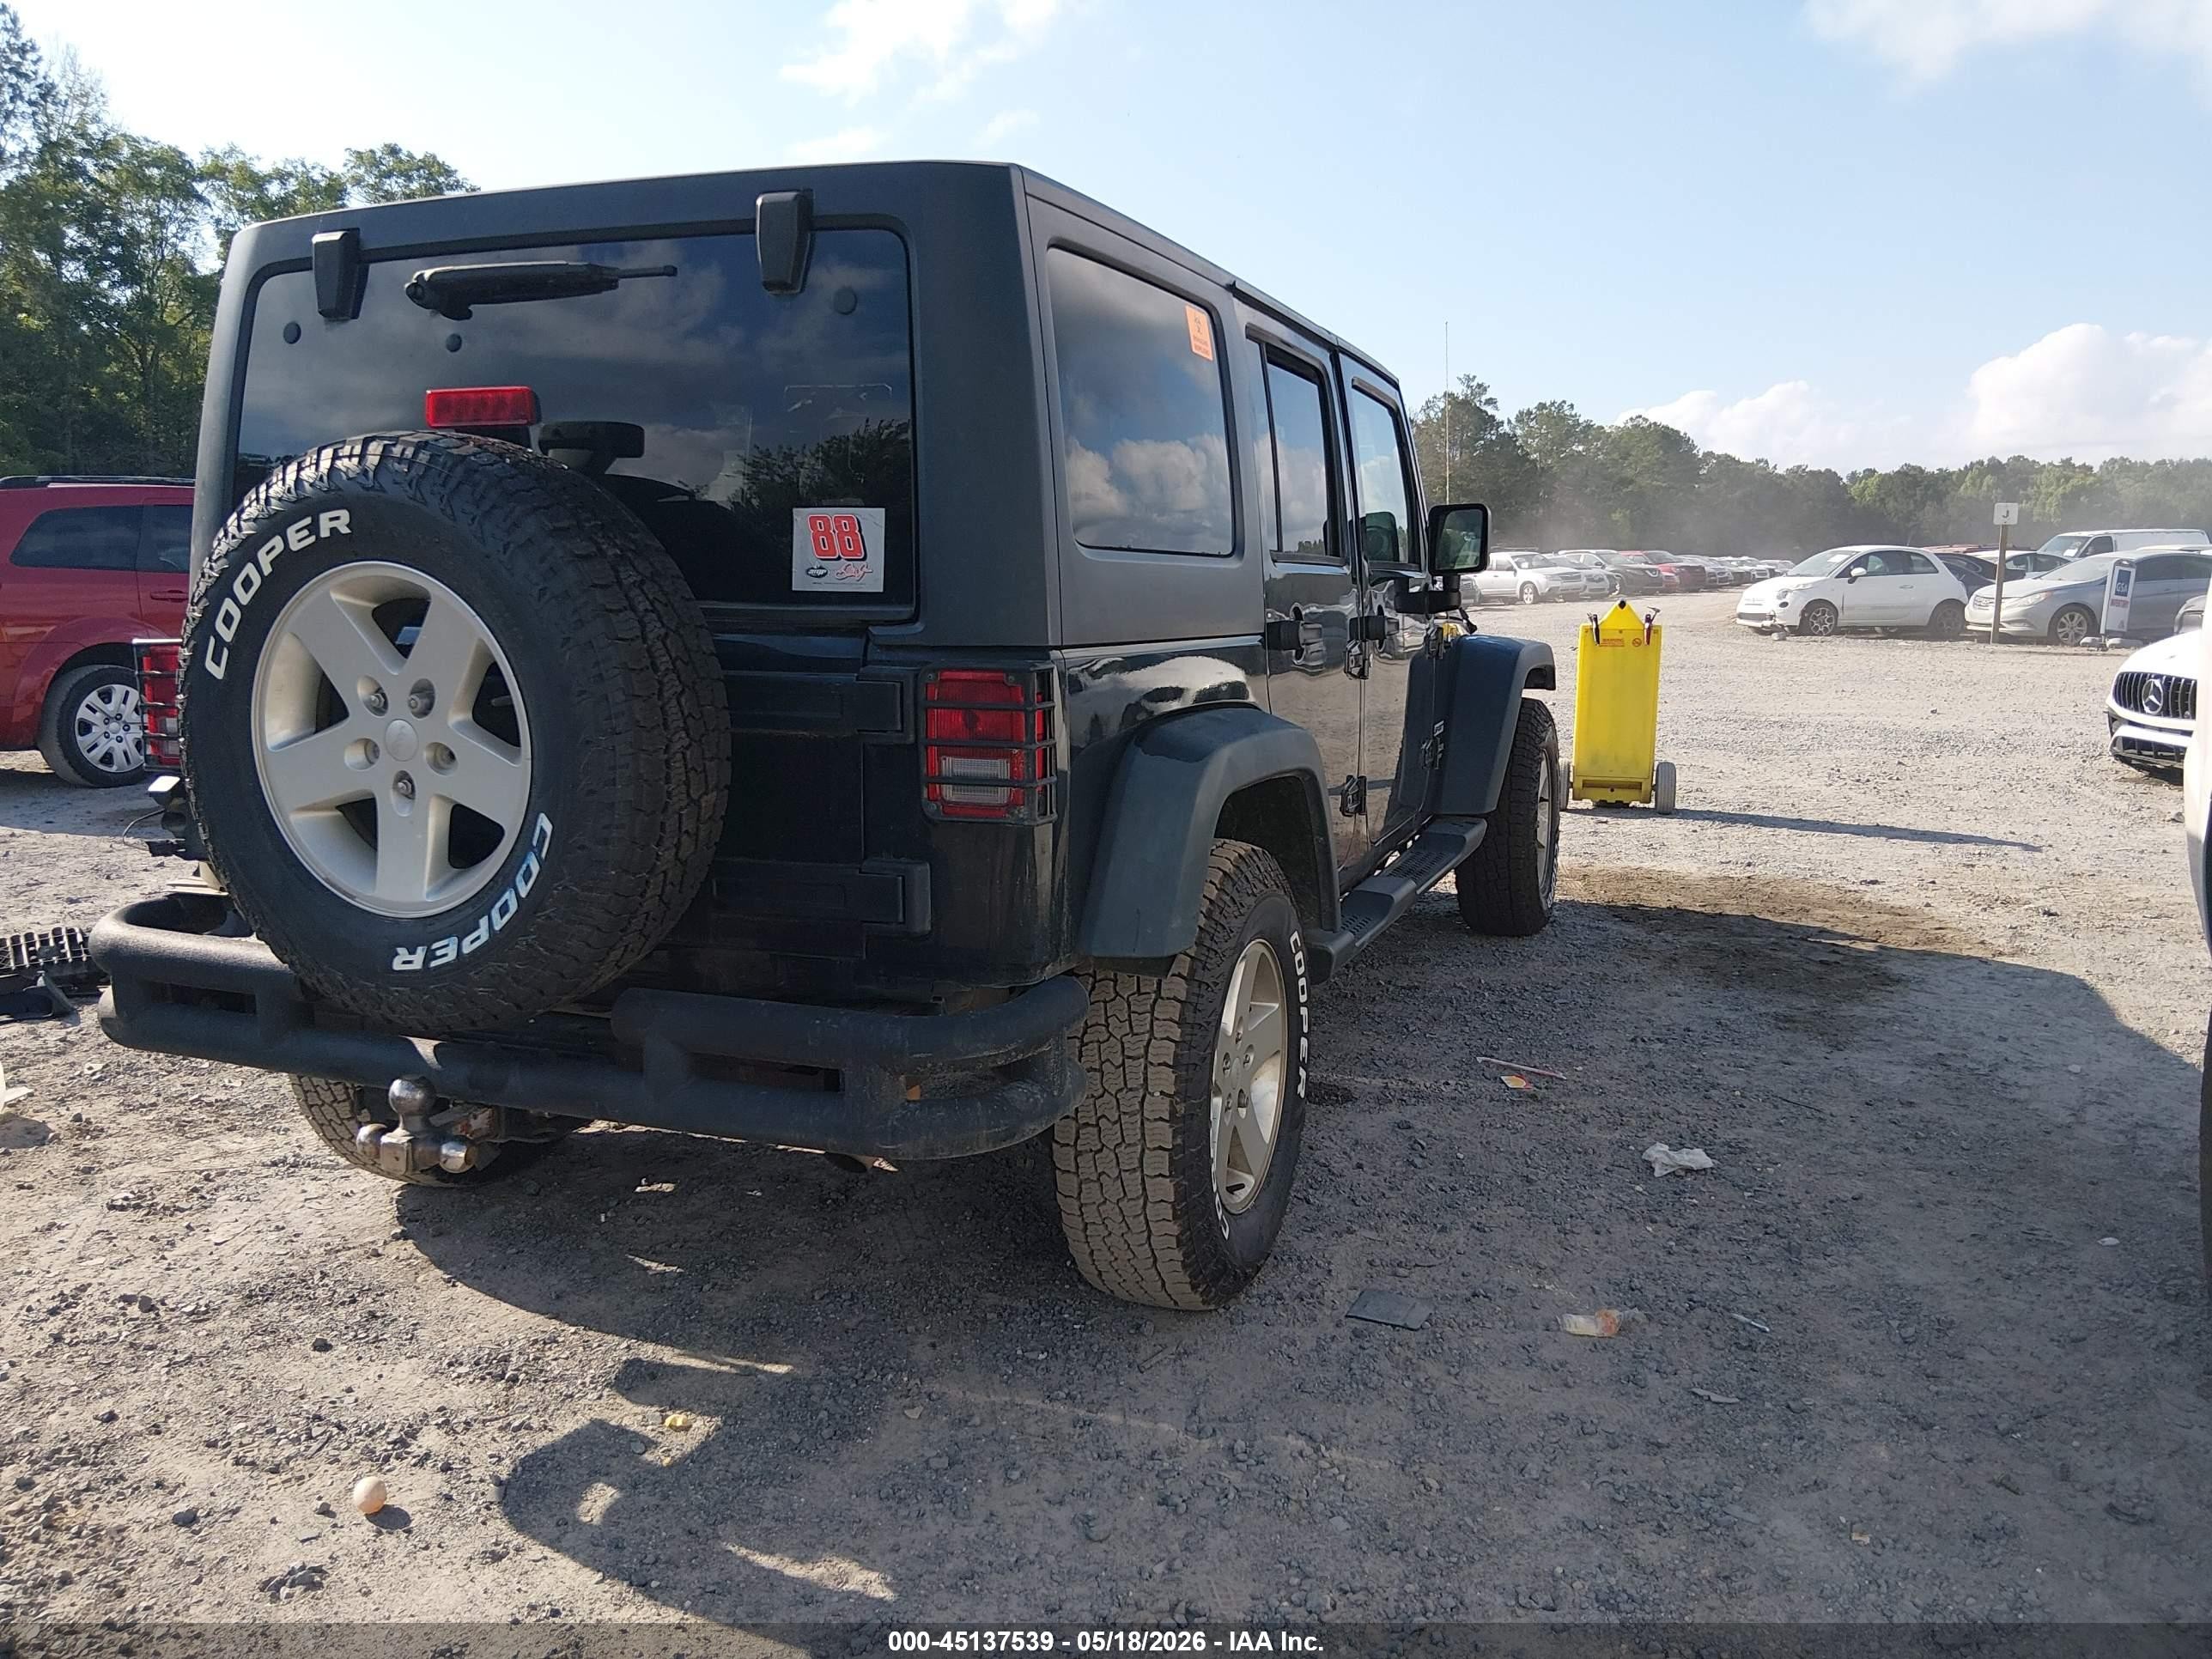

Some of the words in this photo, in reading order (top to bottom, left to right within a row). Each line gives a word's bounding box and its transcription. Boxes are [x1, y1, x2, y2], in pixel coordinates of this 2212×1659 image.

[204, 507, 352, 680] COOPER
[807, 514, 866, 560] 88
[2002, 509, 2009, 519] J
[392, 811, 554, 972] COOPER
[1289, 929, 1310, 1099] COOPER
